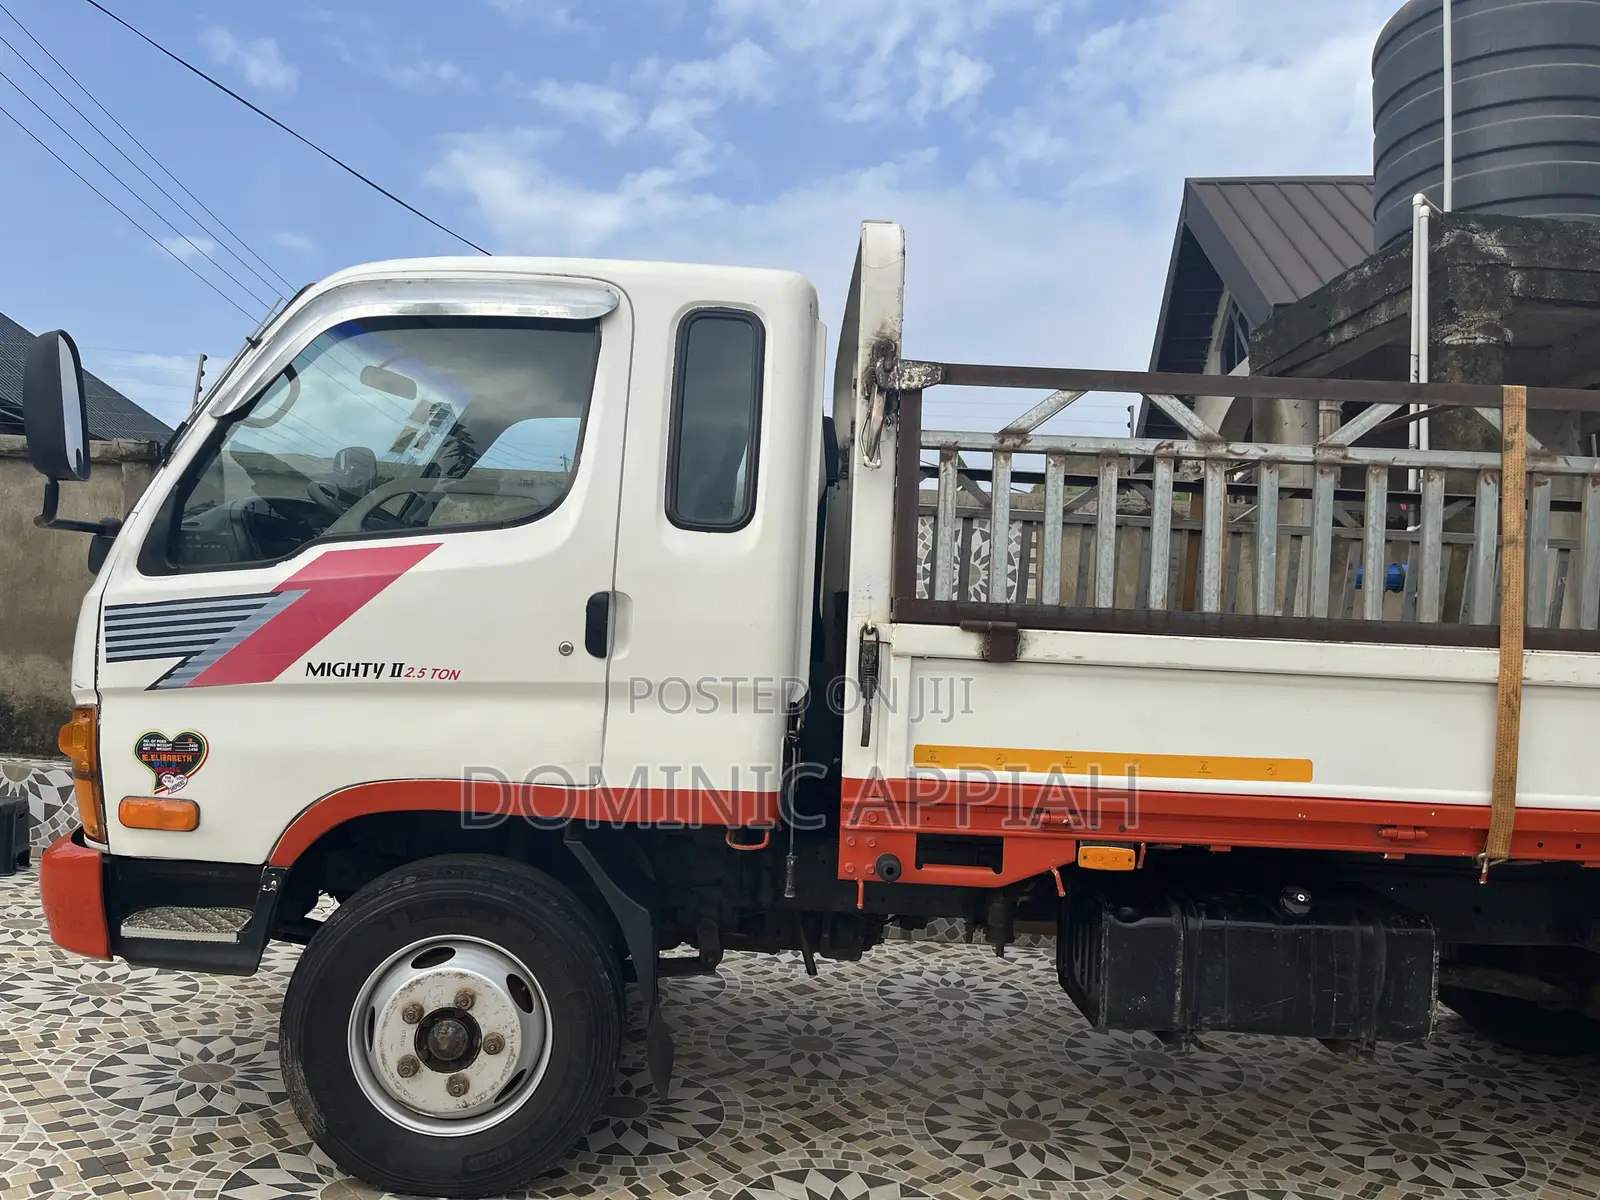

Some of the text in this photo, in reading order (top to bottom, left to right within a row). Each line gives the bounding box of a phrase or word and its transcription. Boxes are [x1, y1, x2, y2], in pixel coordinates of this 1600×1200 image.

[305, 662, 461, 680] MIGHTY II 2.5 TON
